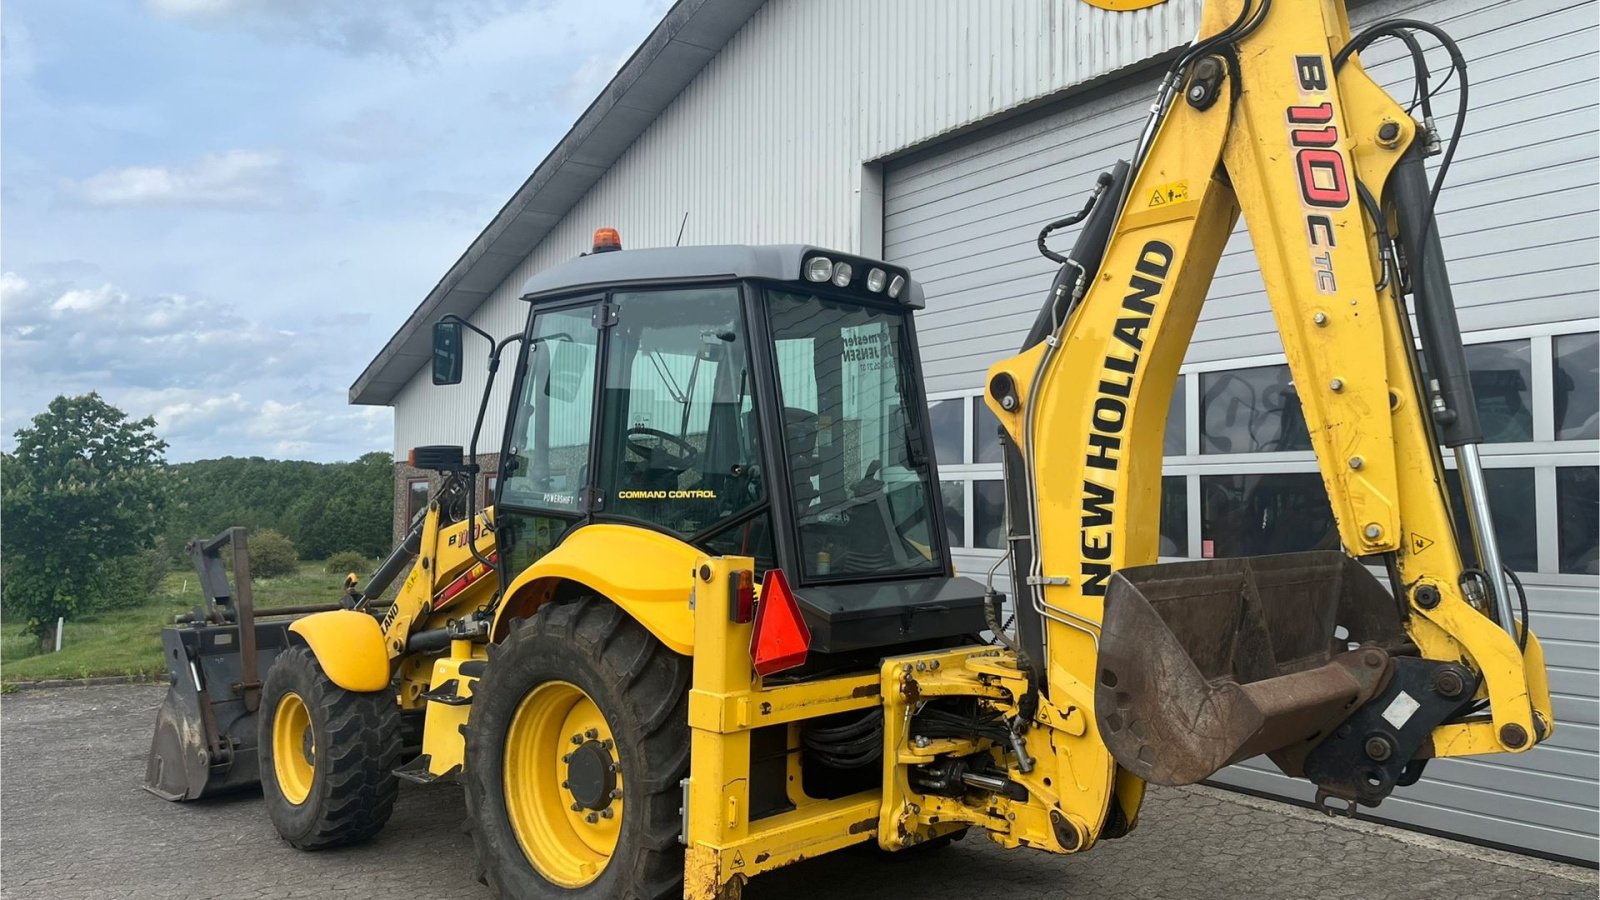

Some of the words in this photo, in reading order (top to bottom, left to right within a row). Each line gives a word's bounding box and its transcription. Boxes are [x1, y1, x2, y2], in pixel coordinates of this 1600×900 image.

[1085, 239, 1176, 472] HOLLAND
[543, 492, 574, 505] POWERSHIFT
[618, 490, 667, 499] COMMAND
[668, 489, 717, 499] CONTROL
[448, 533, 458, 547] B
[1080, 479, 1117, 597] NEW
